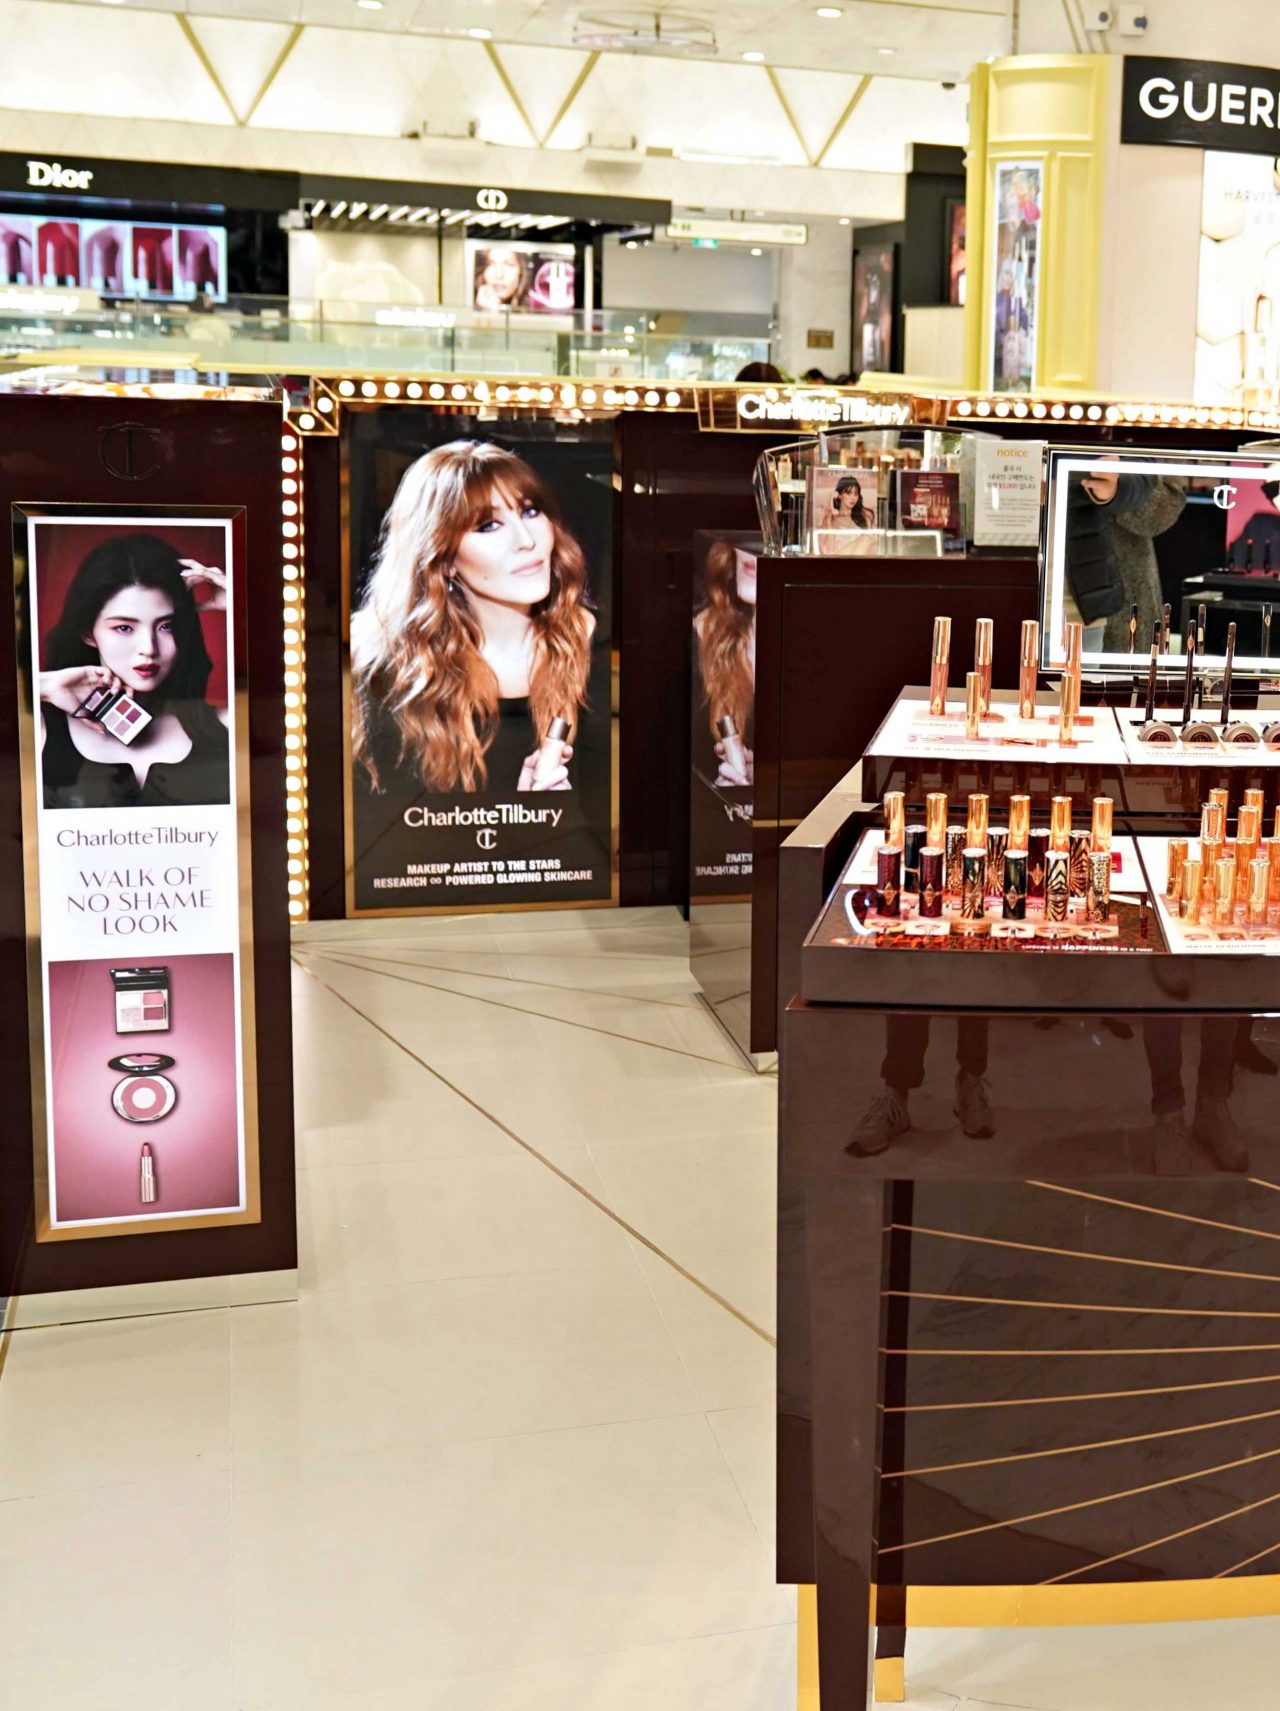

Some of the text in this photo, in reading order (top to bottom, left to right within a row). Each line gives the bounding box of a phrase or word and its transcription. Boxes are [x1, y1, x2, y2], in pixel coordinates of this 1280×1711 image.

[26, 160, 94, 190] Dior
[996, 447, 1029, 458] notice
[79, 866, 201, 889] WALK OF
[406, 859, 561, 875] MAKEUP ARTIST TO THE STARS
[373, 869, 593, 889] RESEARCH POWERED GLOWING SKINCARE
[67, 889, 213, 913] NO SHAME
[103, 914, 178, 936] LOOK
